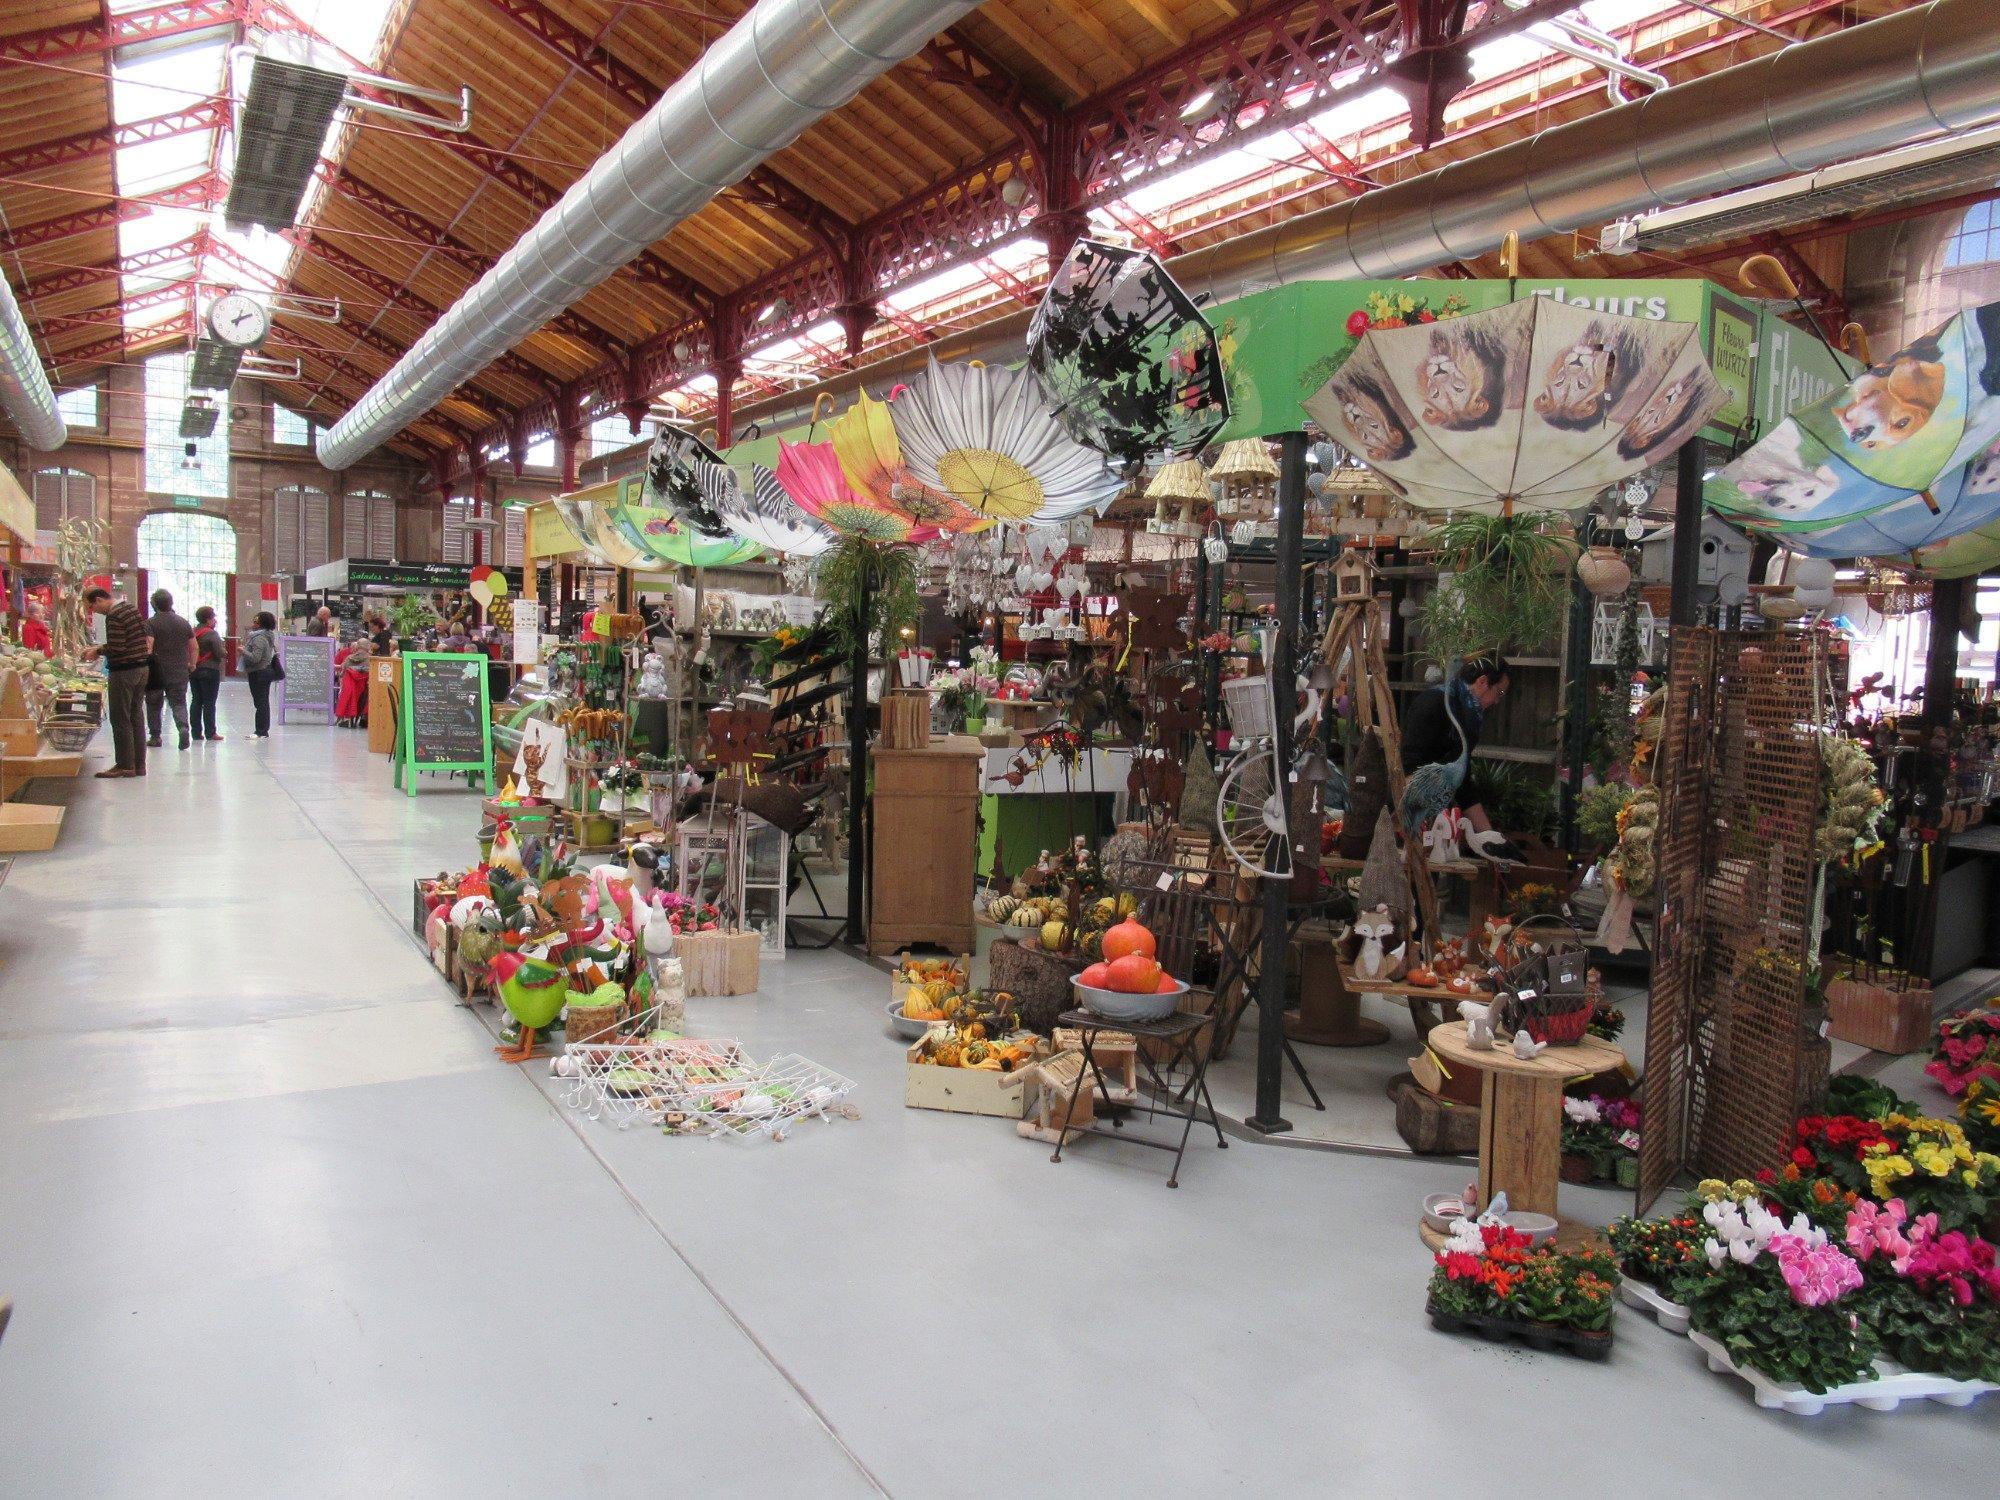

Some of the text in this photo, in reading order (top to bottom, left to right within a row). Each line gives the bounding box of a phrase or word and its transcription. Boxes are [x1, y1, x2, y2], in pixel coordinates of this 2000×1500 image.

[1530, 286, 1667, 321] leurs
[1716, 347, 1747, 378] WURTZ
[1767, 331, 1836, 422] Fleur
[350, 572, 382, 581] Salades
[393, 574, 419, 583] Soupes
[424, 564, 475, 575] Légumez-mo
